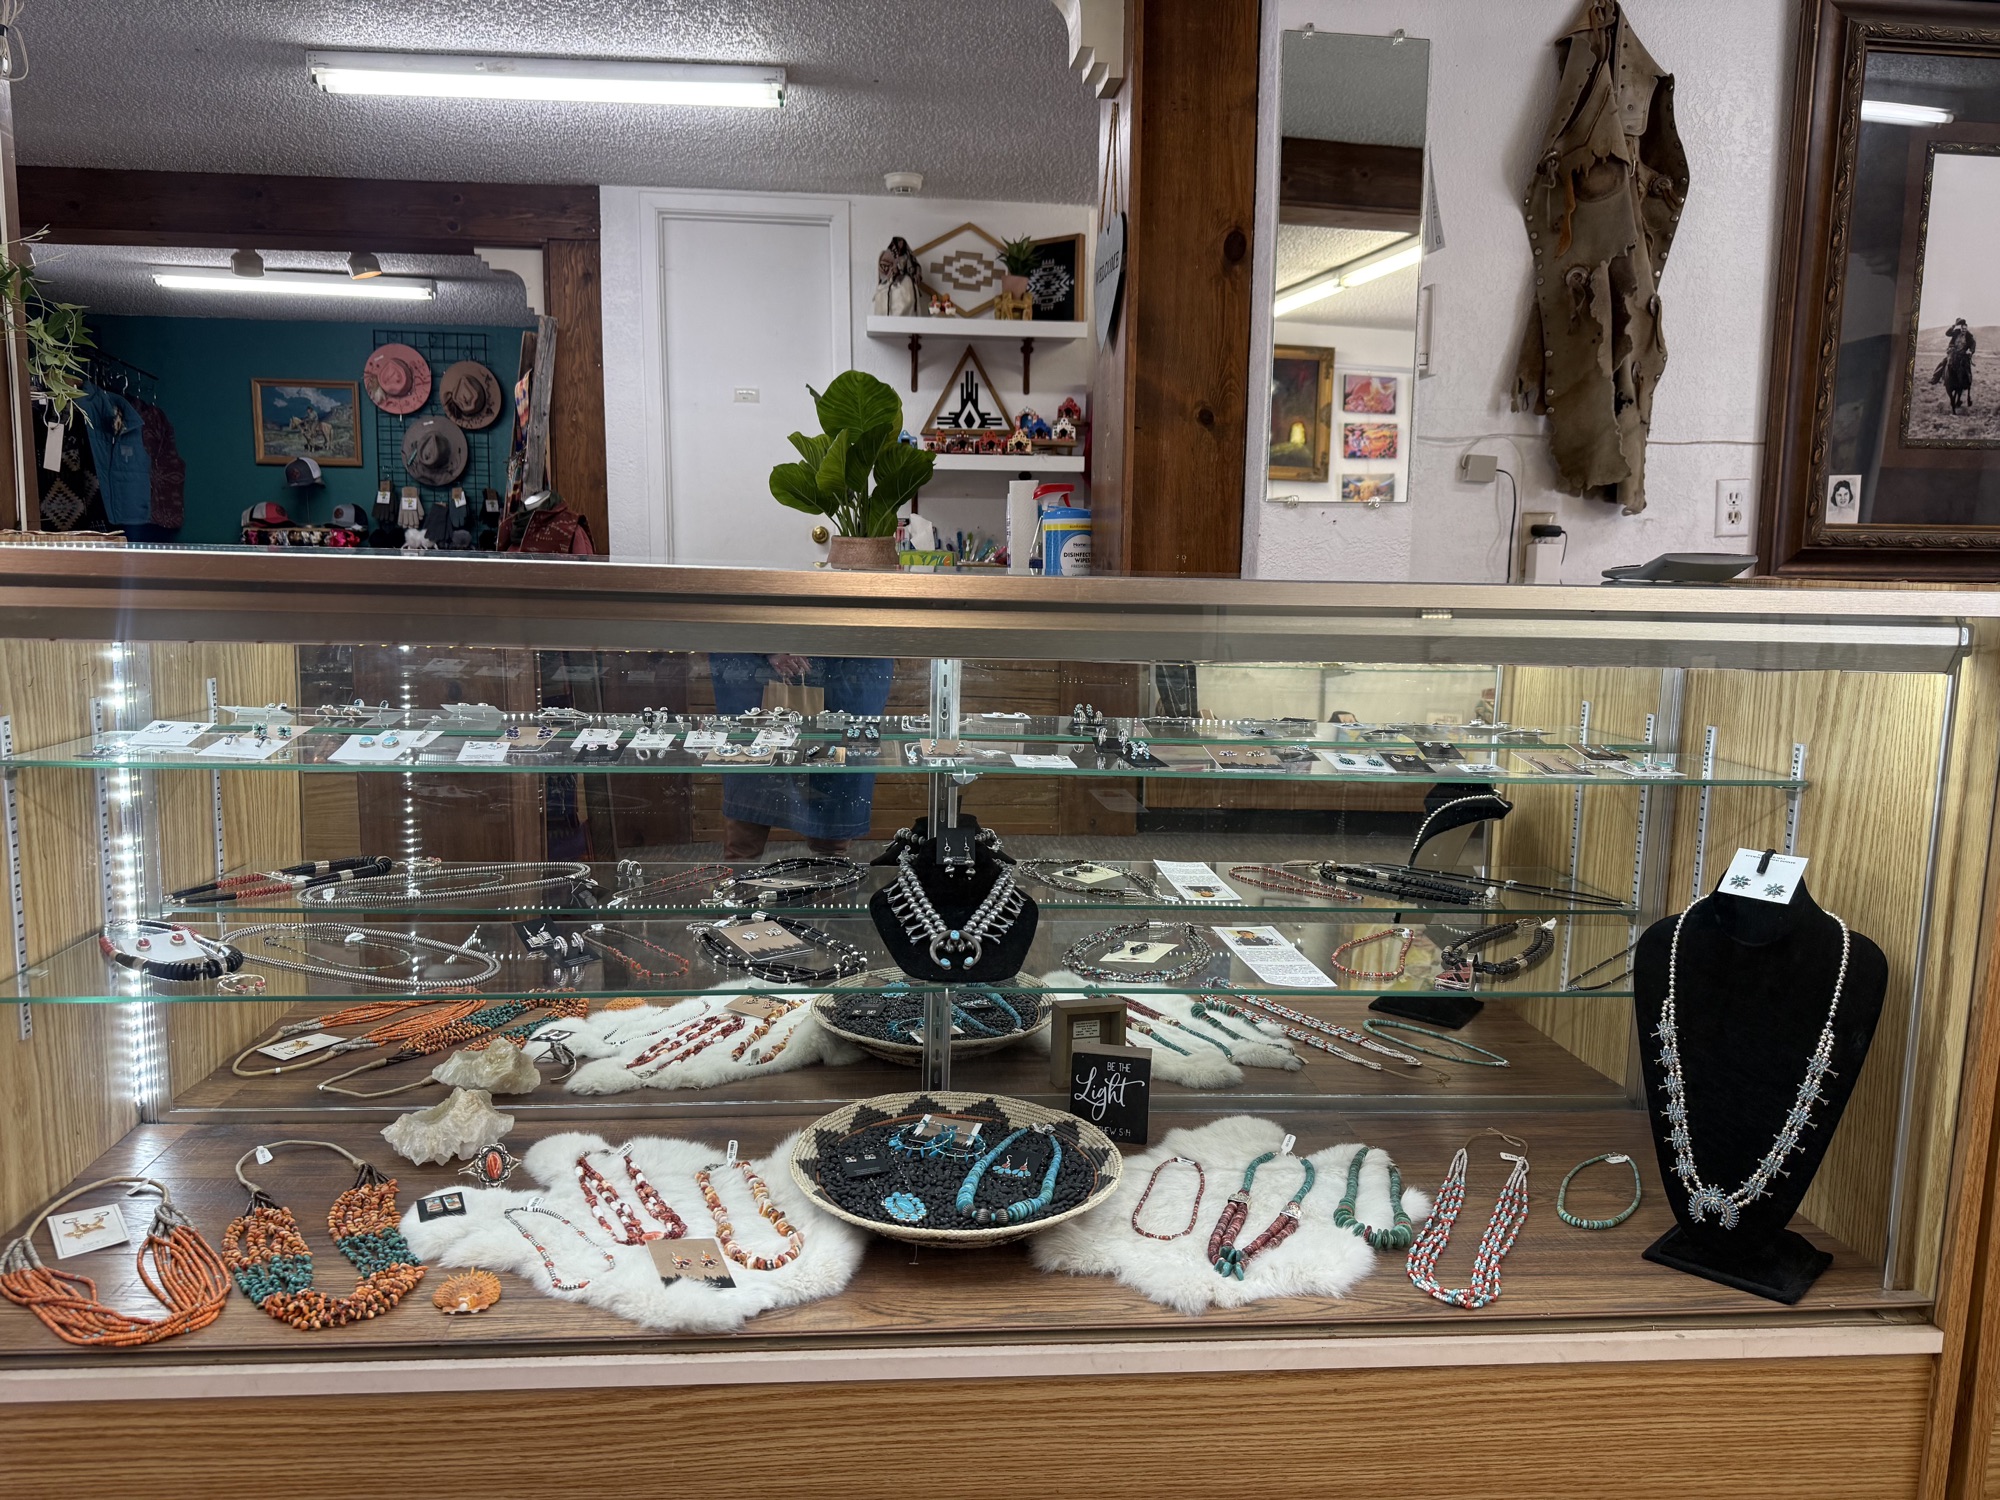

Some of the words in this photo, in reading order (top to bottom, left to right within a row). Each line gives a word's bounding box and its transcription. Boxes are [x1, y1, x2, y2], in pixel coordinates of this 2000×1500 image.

[1095, 250, 1120, 286] WELCOME
[1106, 1061, 1116, 1072] BE
[1118, 1062, 1132, 1073] THE
[1074, 1066, 1145, 1121] Light
